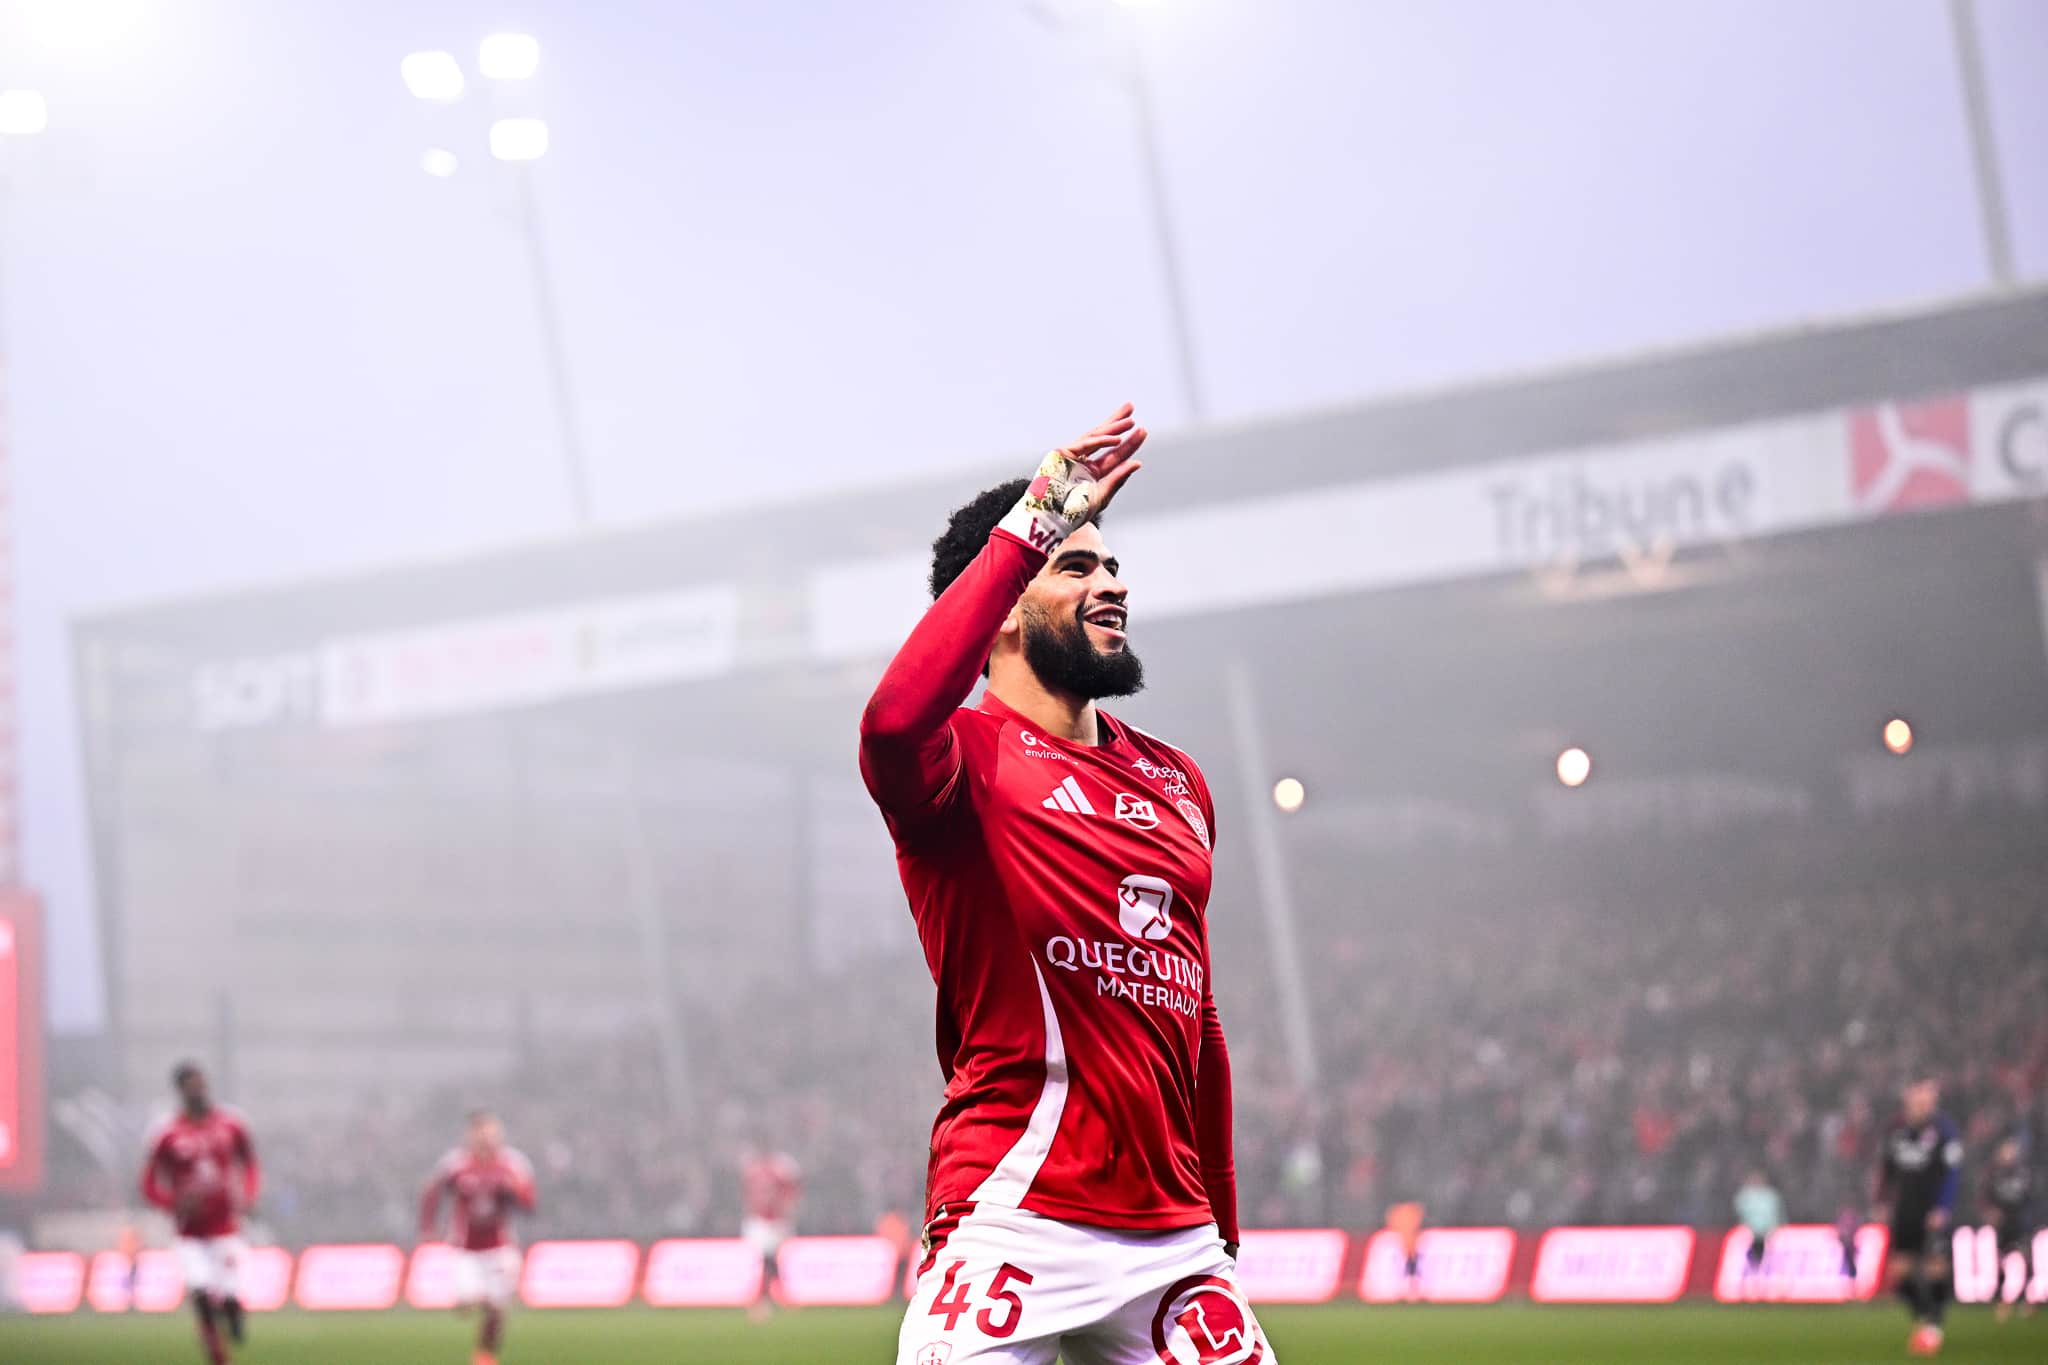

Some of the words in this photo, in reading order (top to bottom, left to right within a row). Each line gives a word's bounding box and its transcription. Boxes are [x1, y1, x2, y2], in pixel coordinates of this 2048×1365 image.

[1488, 458, 1755, 558] Tribune
[1097, 976, 1198, 1020] MATERIAUX
[927, 1260, 1034, 1338] 45
